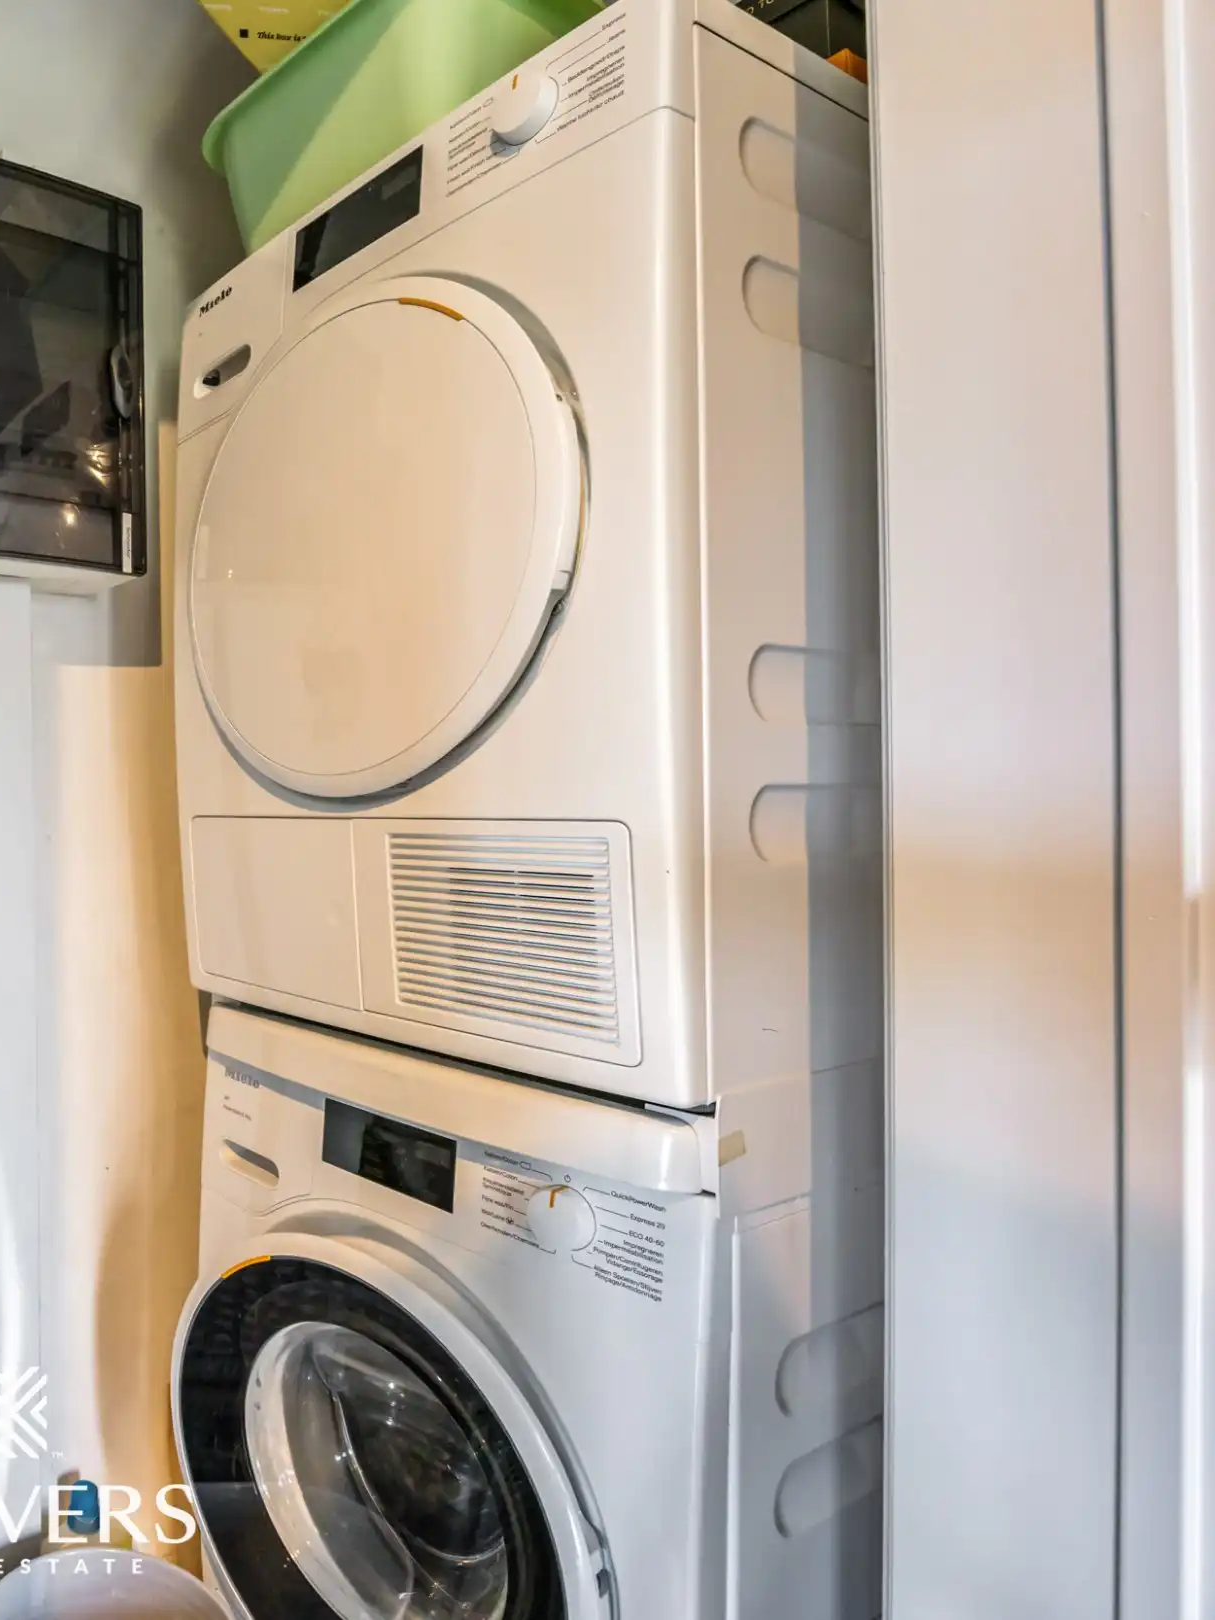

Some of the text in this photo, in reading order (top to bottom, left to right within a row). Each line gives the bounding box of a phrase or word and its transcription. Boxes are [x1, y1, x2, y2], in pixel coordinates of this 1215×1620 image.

[257, 31, 274, 40] This
[198, 286, 233, 318] Miele
[225, 1068, 259, 1088] Miele
[610, 1190, 667, 1212] QuickPowerWash
[629, 1213, 655, 1227] Express
[623, 1239, 664, 1258] Impregneren
[628, 1230, 665, 1248] ECO 40-60
[606, 1257, 664, 1284] Vidange/Essorage
